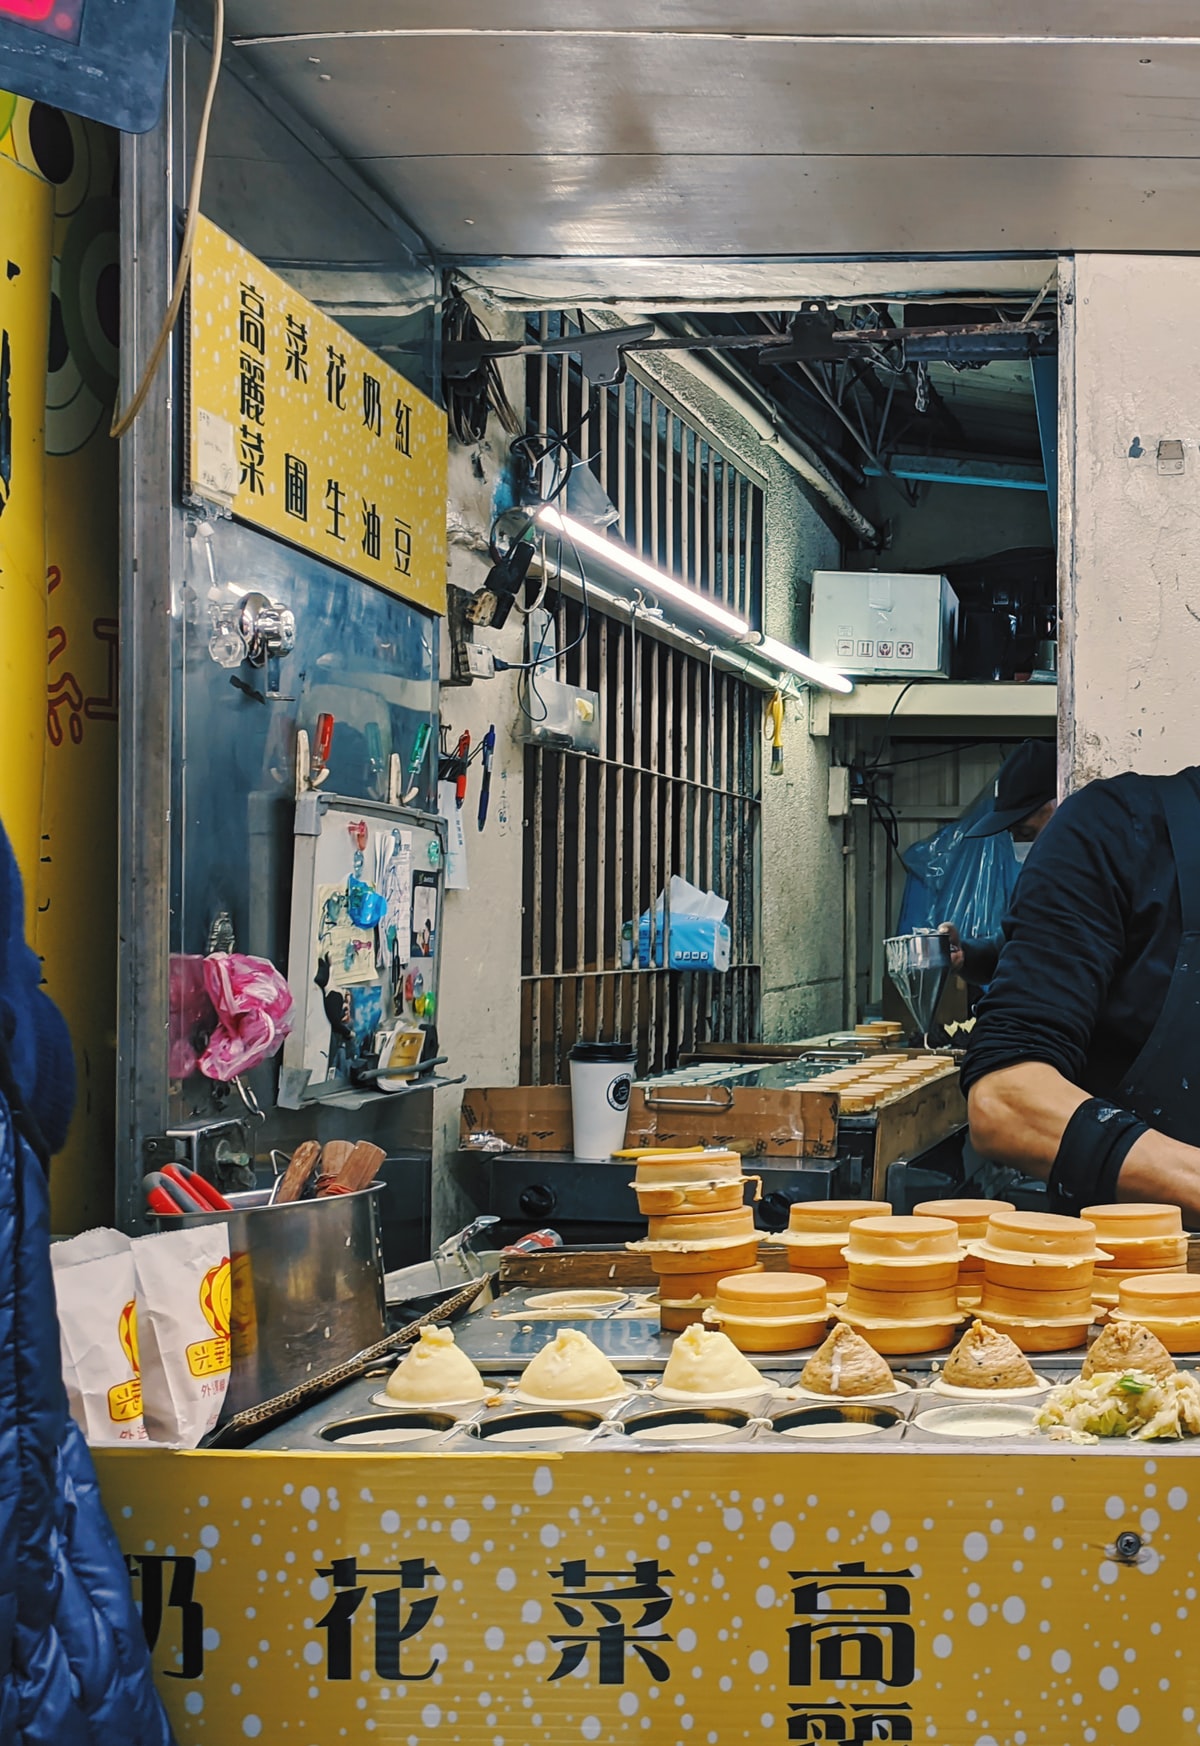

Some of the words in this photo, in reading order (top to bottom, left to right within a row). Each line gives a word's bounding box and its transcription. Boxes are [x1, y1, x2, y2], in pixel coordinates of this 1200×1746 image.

[239, 280, 266, 497] 高麗菜
[284, 313, 309, 523] 菜圃
[325, 344, 347, 542] 花生
[361, 371, 382, 562] 奶油
[394, 398, 413, 578] 紅豆
[315, 1557, 441, 1681] 花
[547, 1560, 675, 1685] 菜
